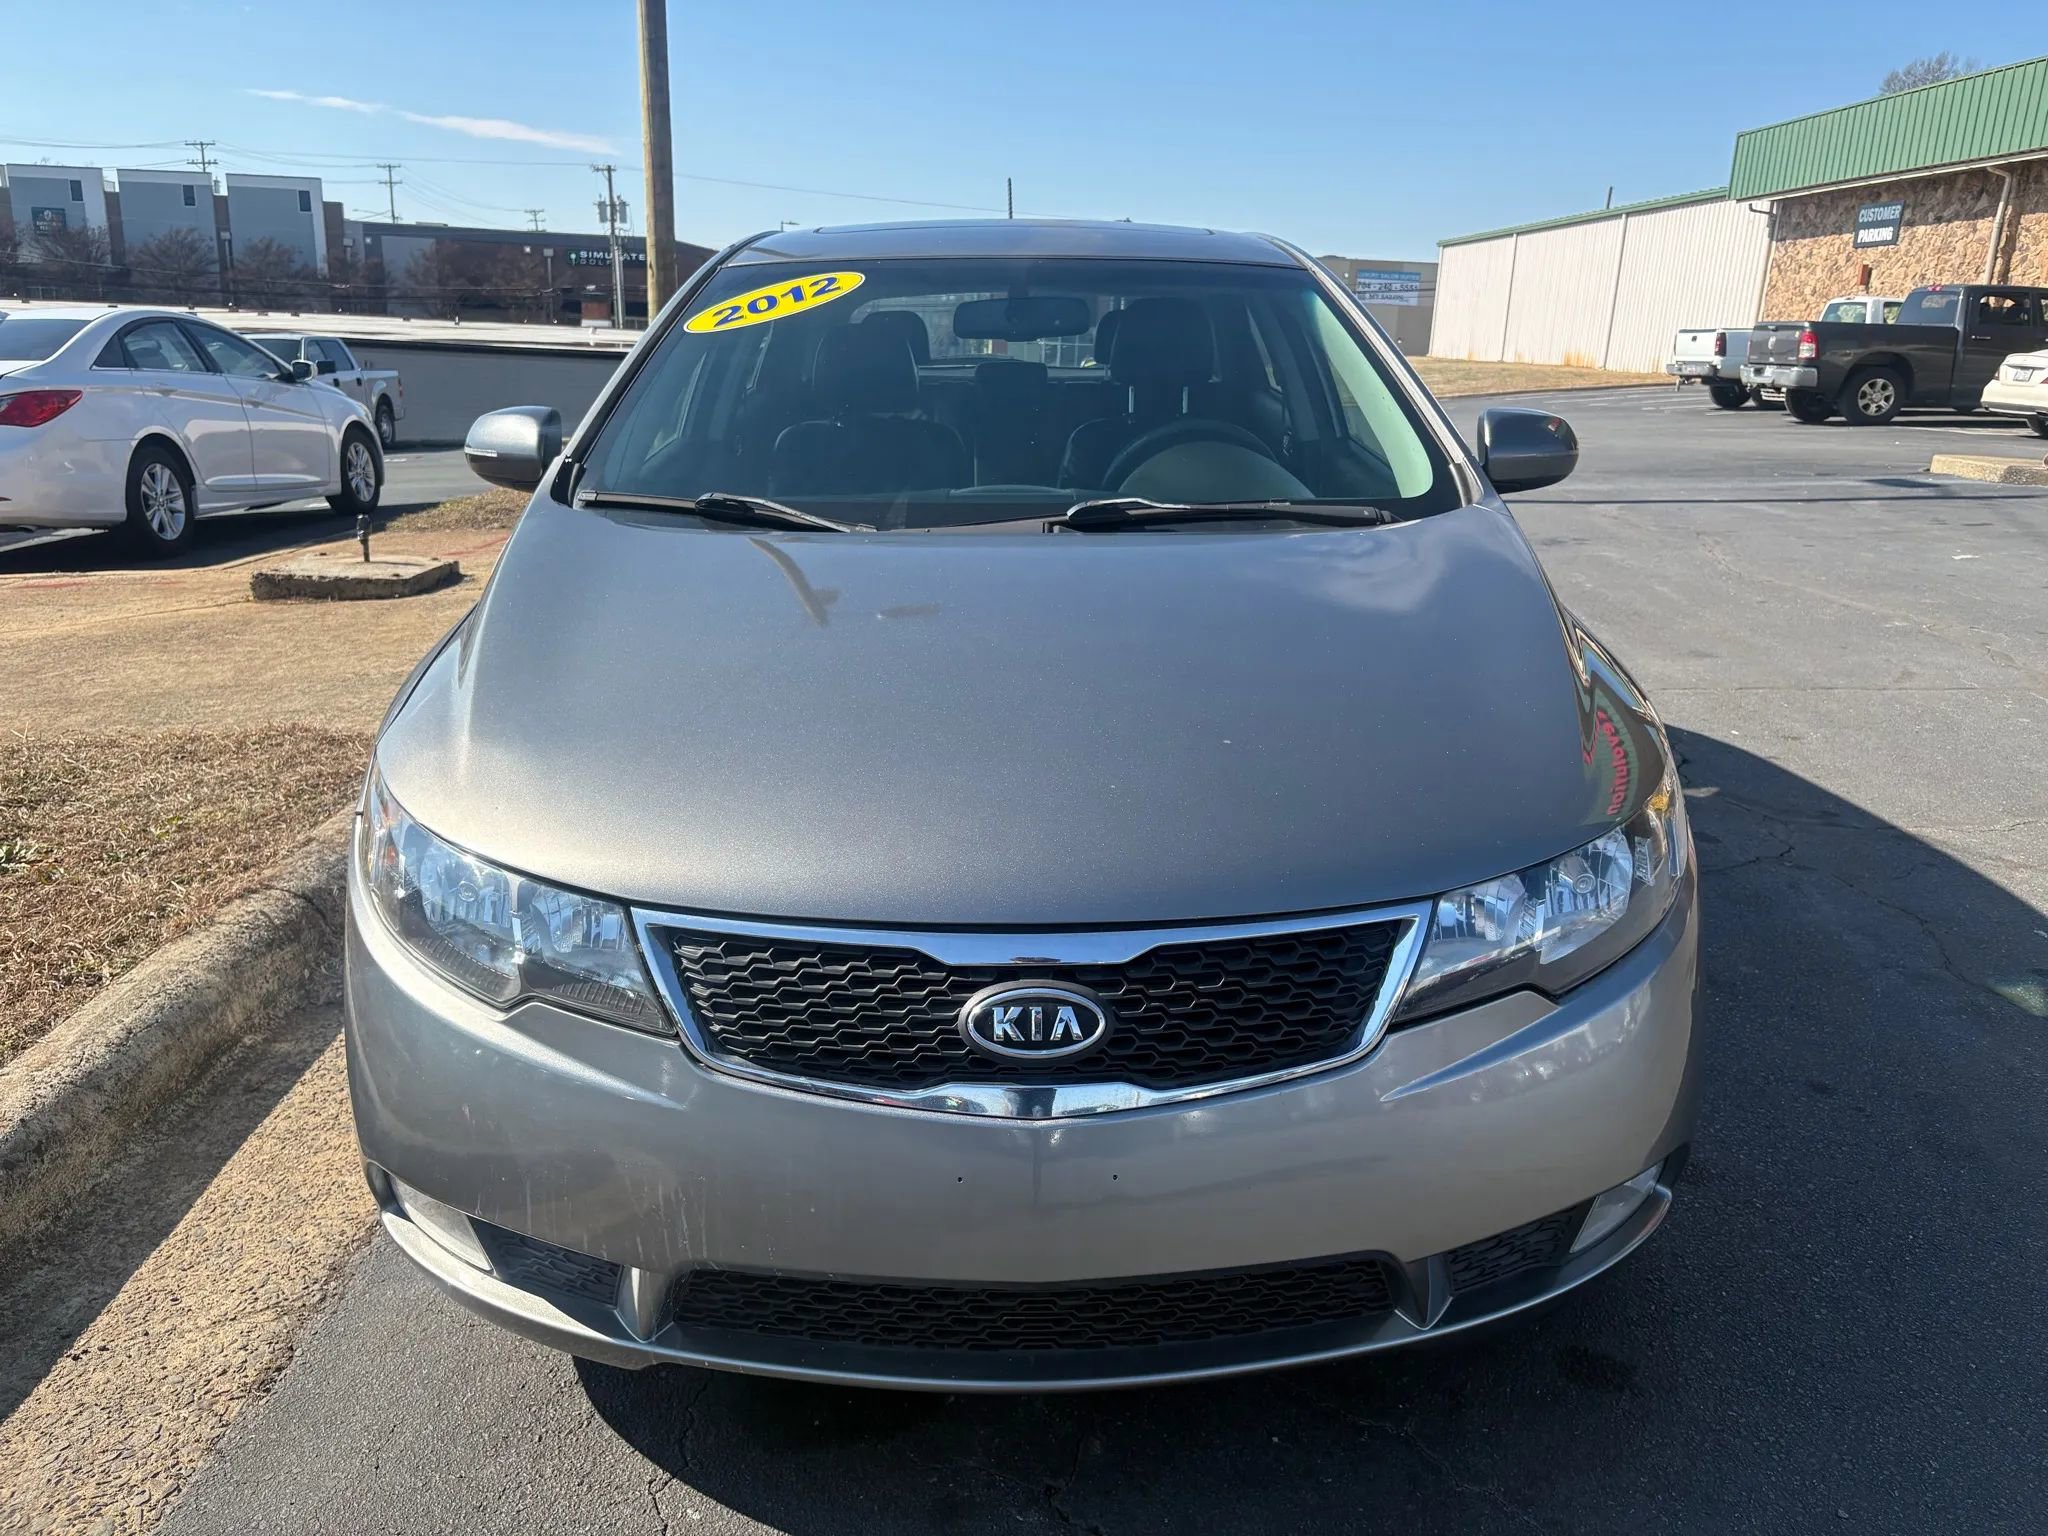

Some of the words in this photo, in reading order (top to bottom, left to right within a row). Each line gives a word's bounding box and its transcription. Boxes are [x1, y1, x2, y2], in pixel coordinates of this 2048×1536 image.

[1858, 205, 1902, 222] CUSTOMER
[1857, 226, 1894, 243] PARKING
[579, 250, 646, 261] SIMUATE
[712, 276, 842, 328] 2012
[991, 1006, 1084, 1042] KIA
